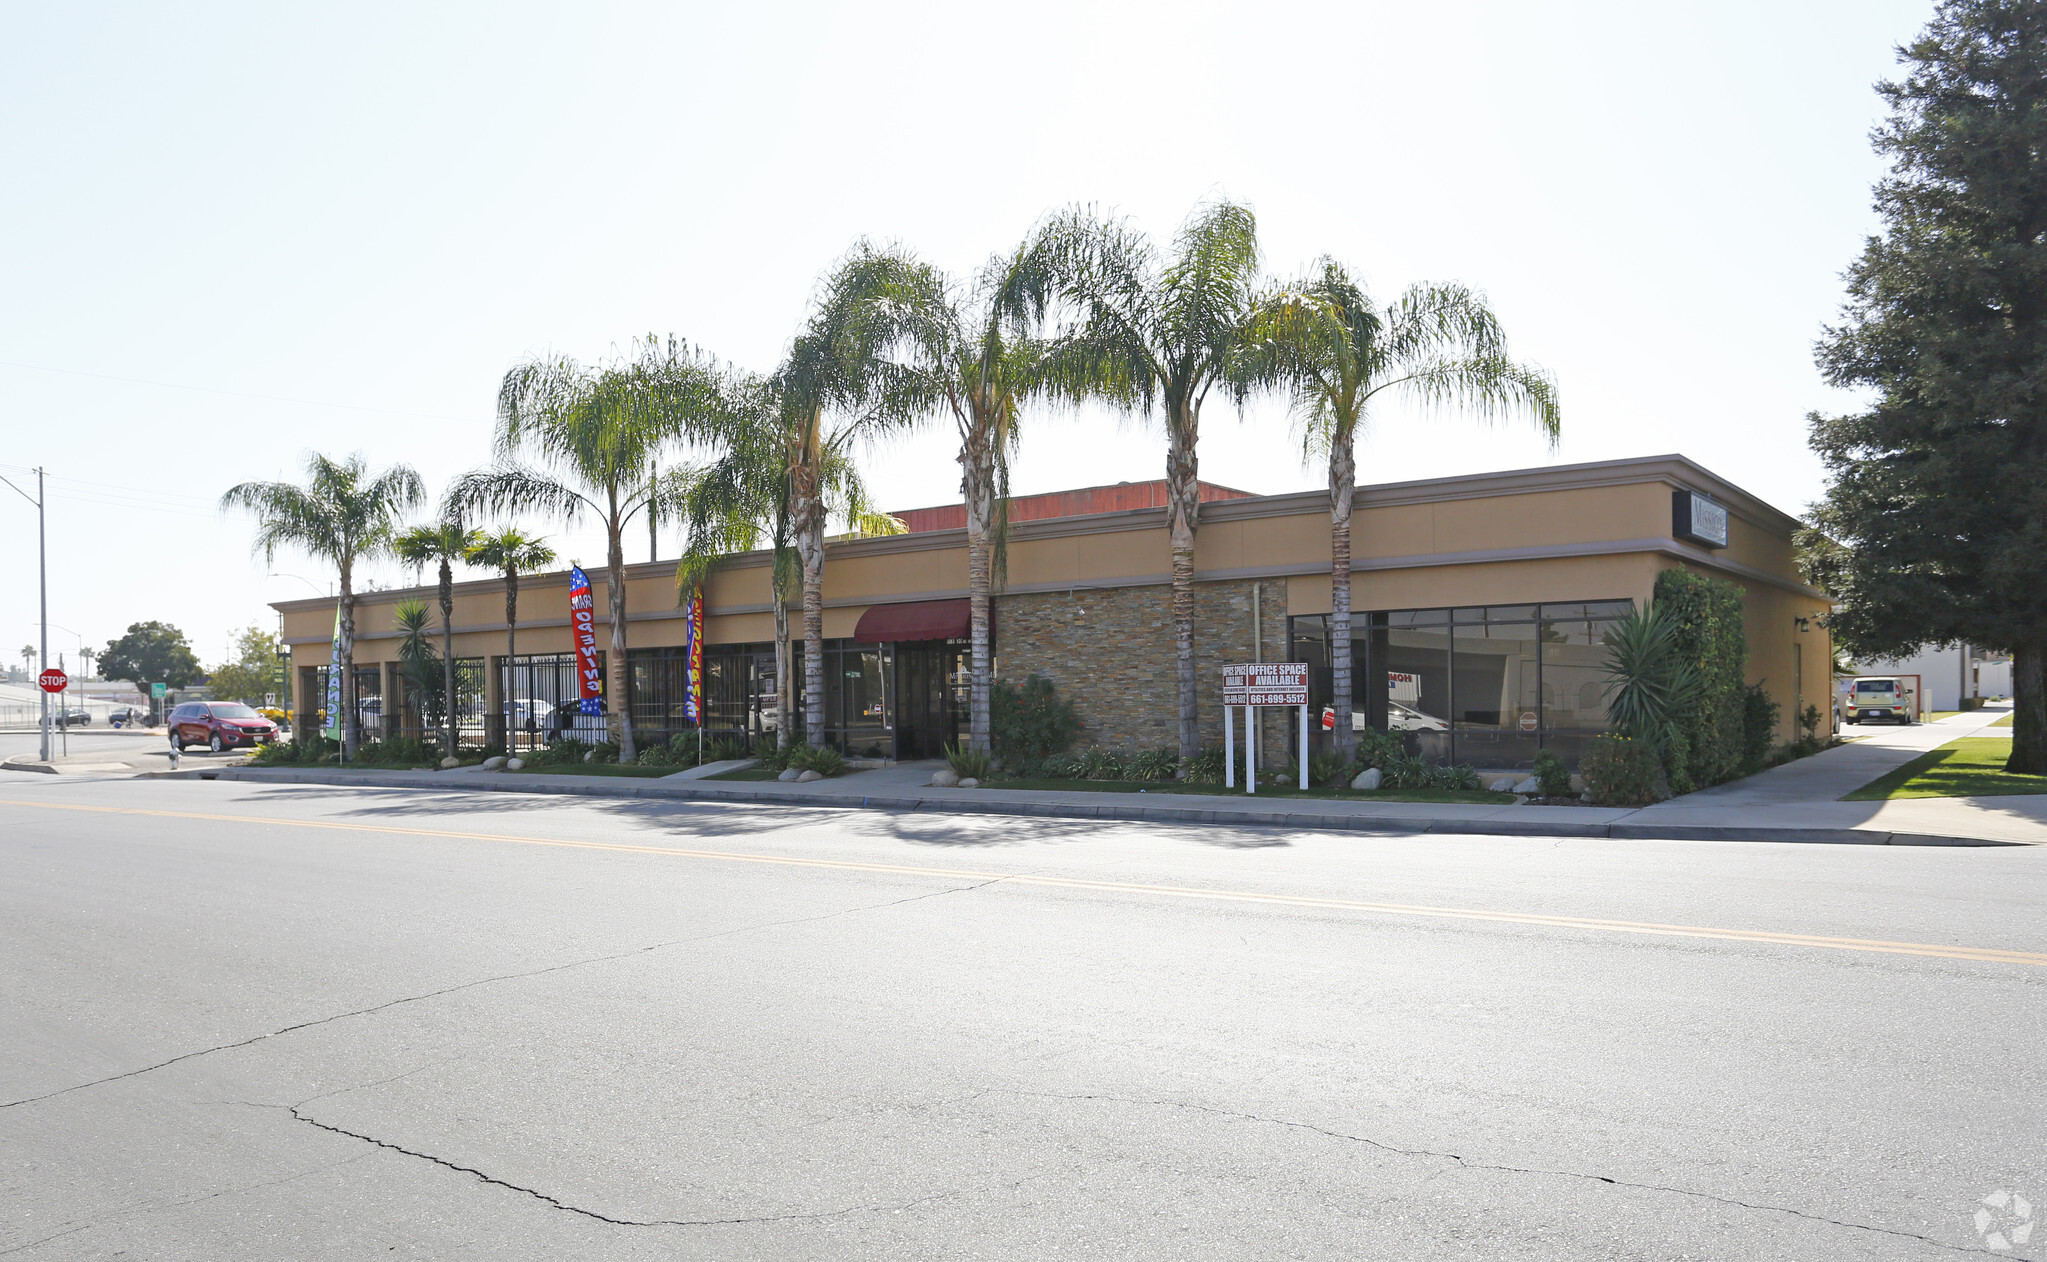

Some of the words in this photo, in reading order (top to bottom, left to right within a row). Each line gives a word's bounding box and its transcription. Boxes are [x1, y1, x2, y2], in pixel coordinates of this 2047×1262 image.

[1248, 665, 1278, 675] OFFICE
[1279, 664, 1306, 675] SPACE
[40, 676, 67, 686] STOP
[1255, 675, 1300, 686] AVAILABLE
[1250, 694, 1306, 704] 661-699-5512
